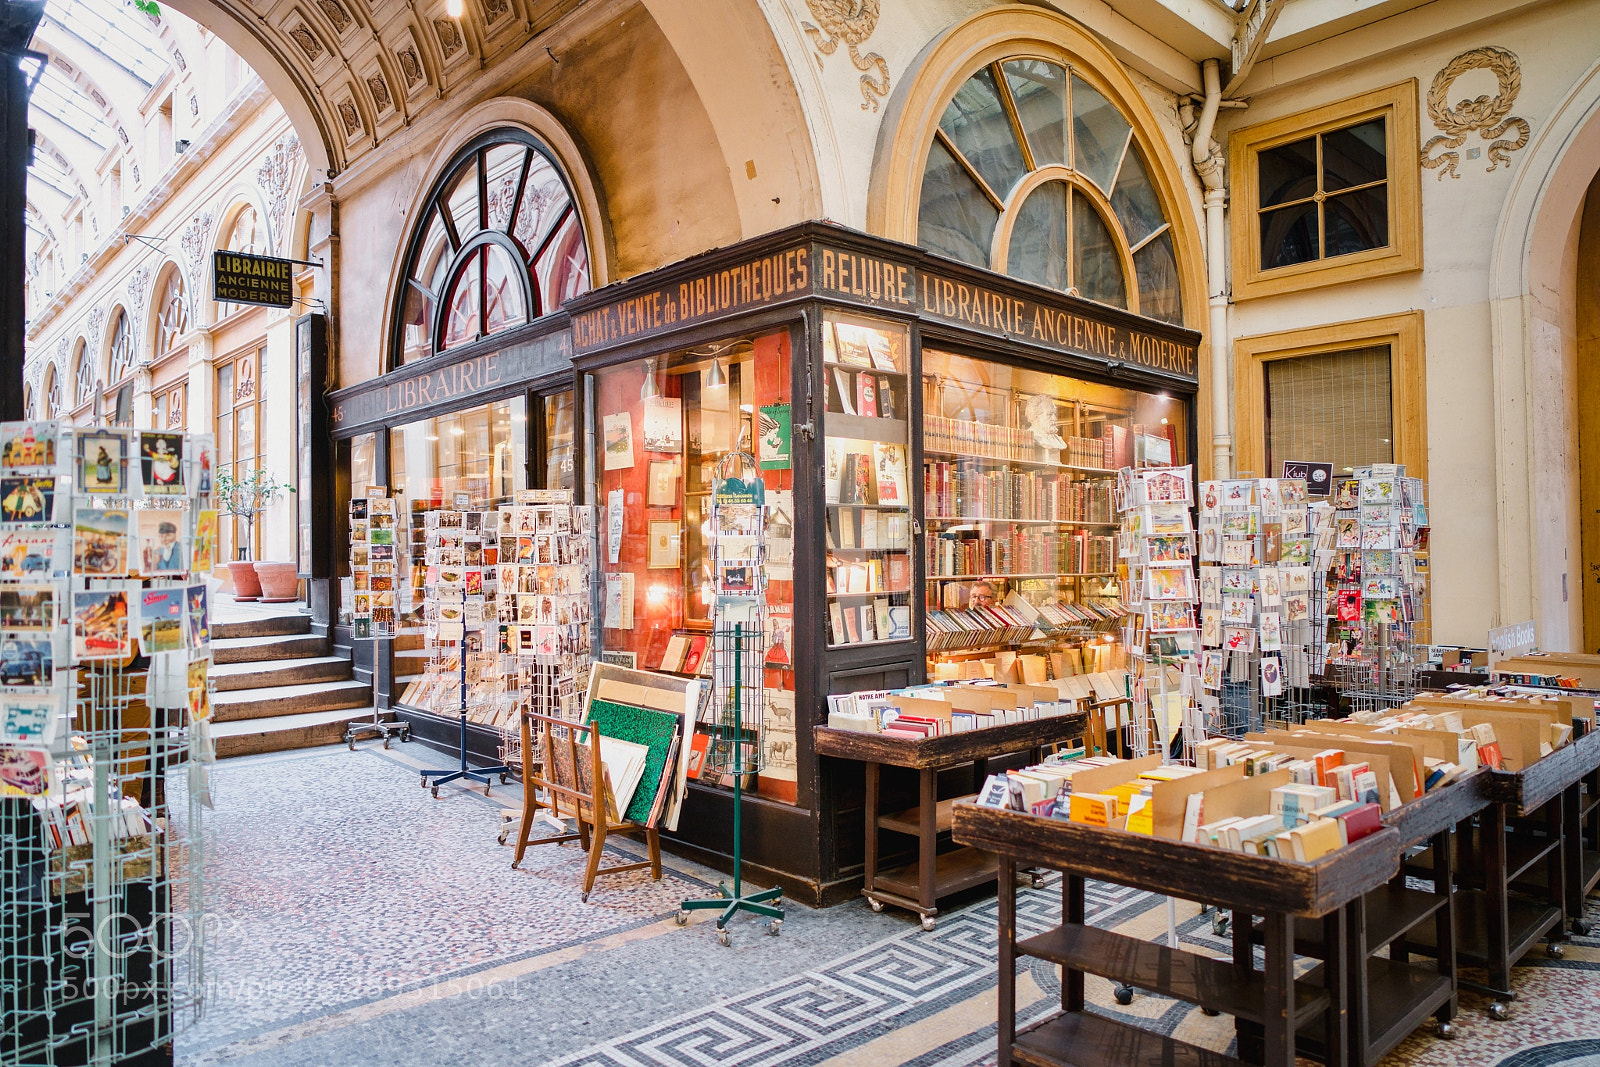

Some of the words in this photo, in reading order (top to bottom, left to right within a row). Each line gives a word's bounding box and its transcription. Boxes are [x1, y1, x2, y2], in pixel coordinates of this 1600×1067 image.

[216, 254, 290, 279] LIBRAIRIE
[822, 248, 909, 306] RELIURE
[217, 287, 290, 304] MODERNE
[218, 274, 289, 292] ANCIENNE
[574, 307, 611, 349] ACHAT
[611, 319, 619, 340] &
[619, 291, 661, 335] VENTE
[664, 293, 677, 324] de
[679, 248, 808, 321] BIBLIOTHEQUES
[922, 274, 1026, 336] LIBRAIRIE
[1031, 305, 1117, 358] ANCIENNE
[1119, 341, 1127, 359] &
[1129, 331, 1194, 376] MODERNE
[386, 353, 502, 413] LIBRAIRIE
[560, 459, 574, 473] 45
[1491, 629, 1516, 651] English
[1516, 624, 1535, 647] Books
[859, 693, 874, 701] NOTRE
